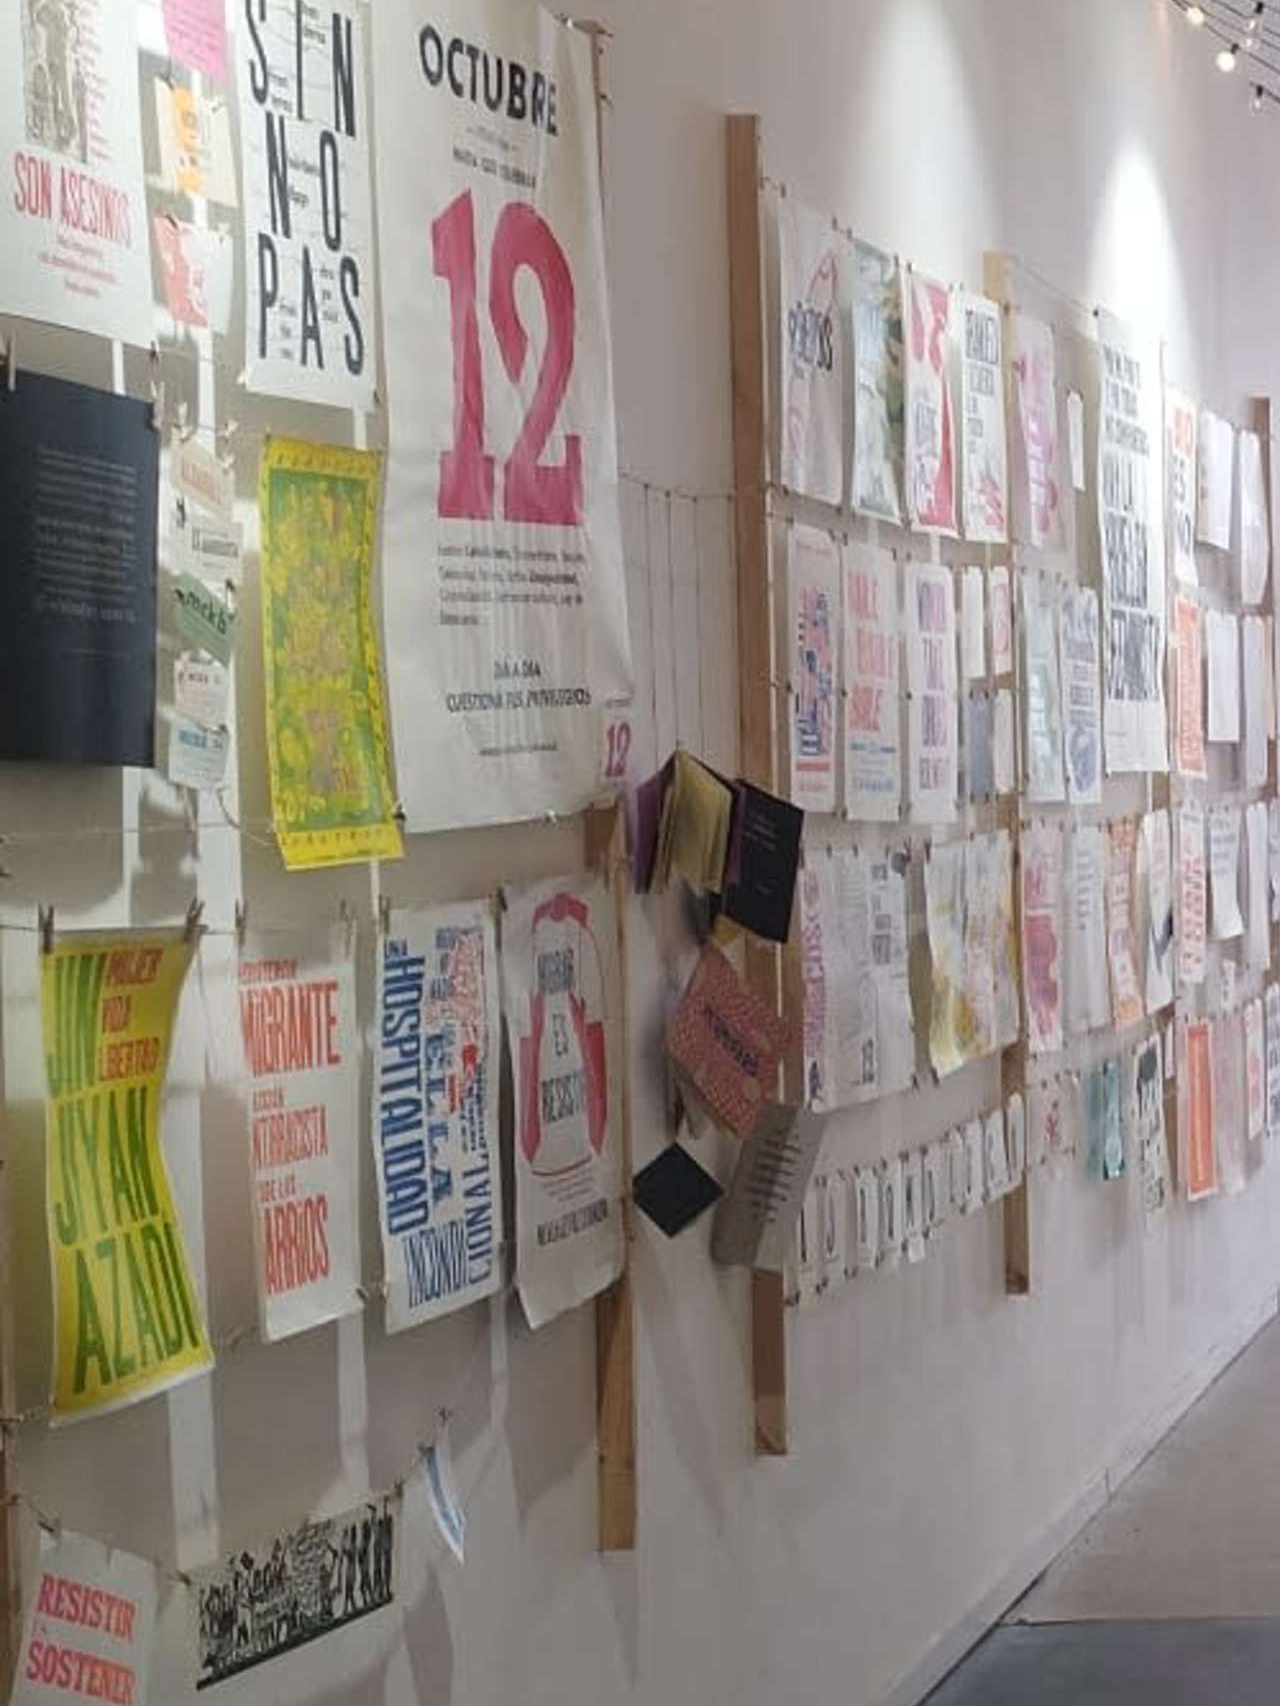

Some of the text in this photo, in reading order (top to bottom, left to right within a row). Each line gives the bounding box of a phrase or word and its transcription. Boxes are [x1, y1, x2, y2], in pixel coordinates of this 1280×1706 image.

[419, 23, 557, 136] OCTUBRE
[14, 151, 52, 219] SON
[265, 111, 342, 252] NO
[258, 233, 365, 375] PAS
[432, 188, 584, 526] 12
[240, 981, 341, 1078] MIGRANTE
[380, 953, 430, 1235] HOSPITALIDAD
[36, 1573, 136, 1643] RESISTIR
[26, 1639, 136, 1706] SOSTENER
